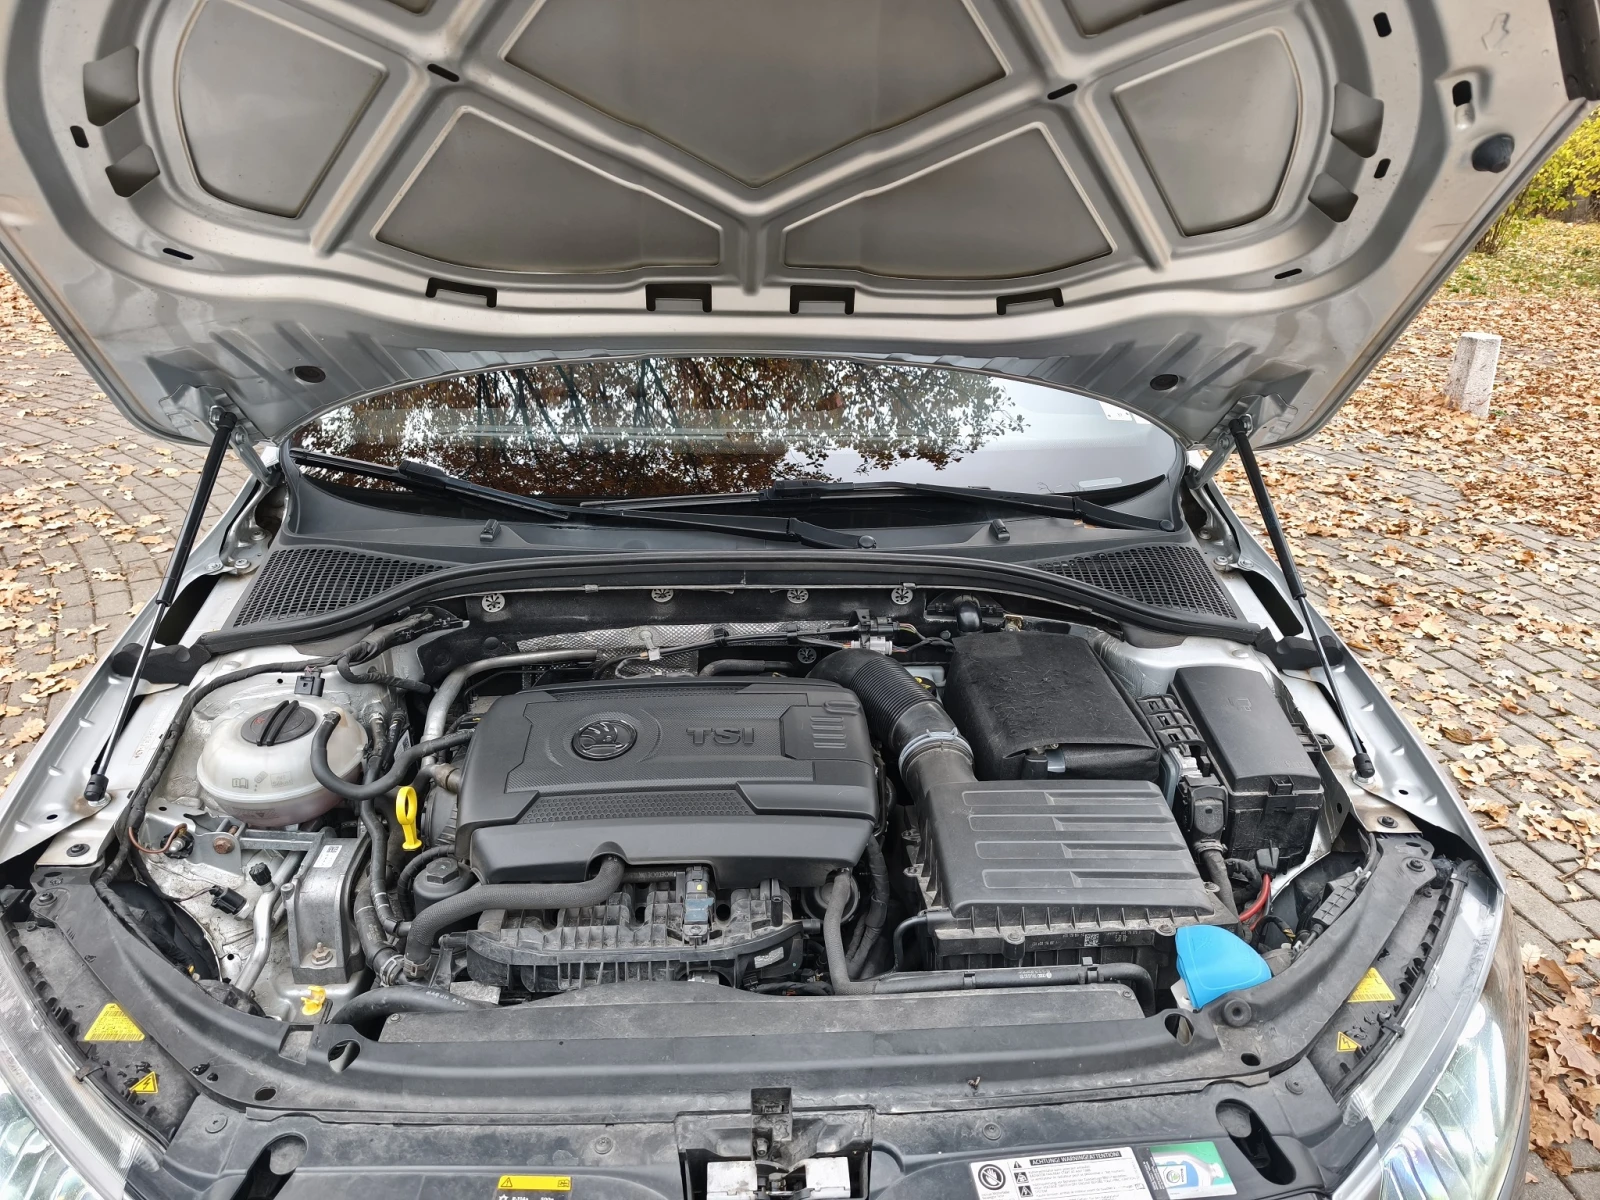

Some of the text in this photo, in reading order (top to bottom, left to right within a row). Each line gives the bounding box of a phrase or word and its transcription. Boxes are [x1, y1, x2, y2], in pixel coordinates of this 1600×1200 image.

[686, 727, 755, 745] TSI
[1032, 1151, 1120, 1165] ACHTUNG! WARNING! ATTENTION!
